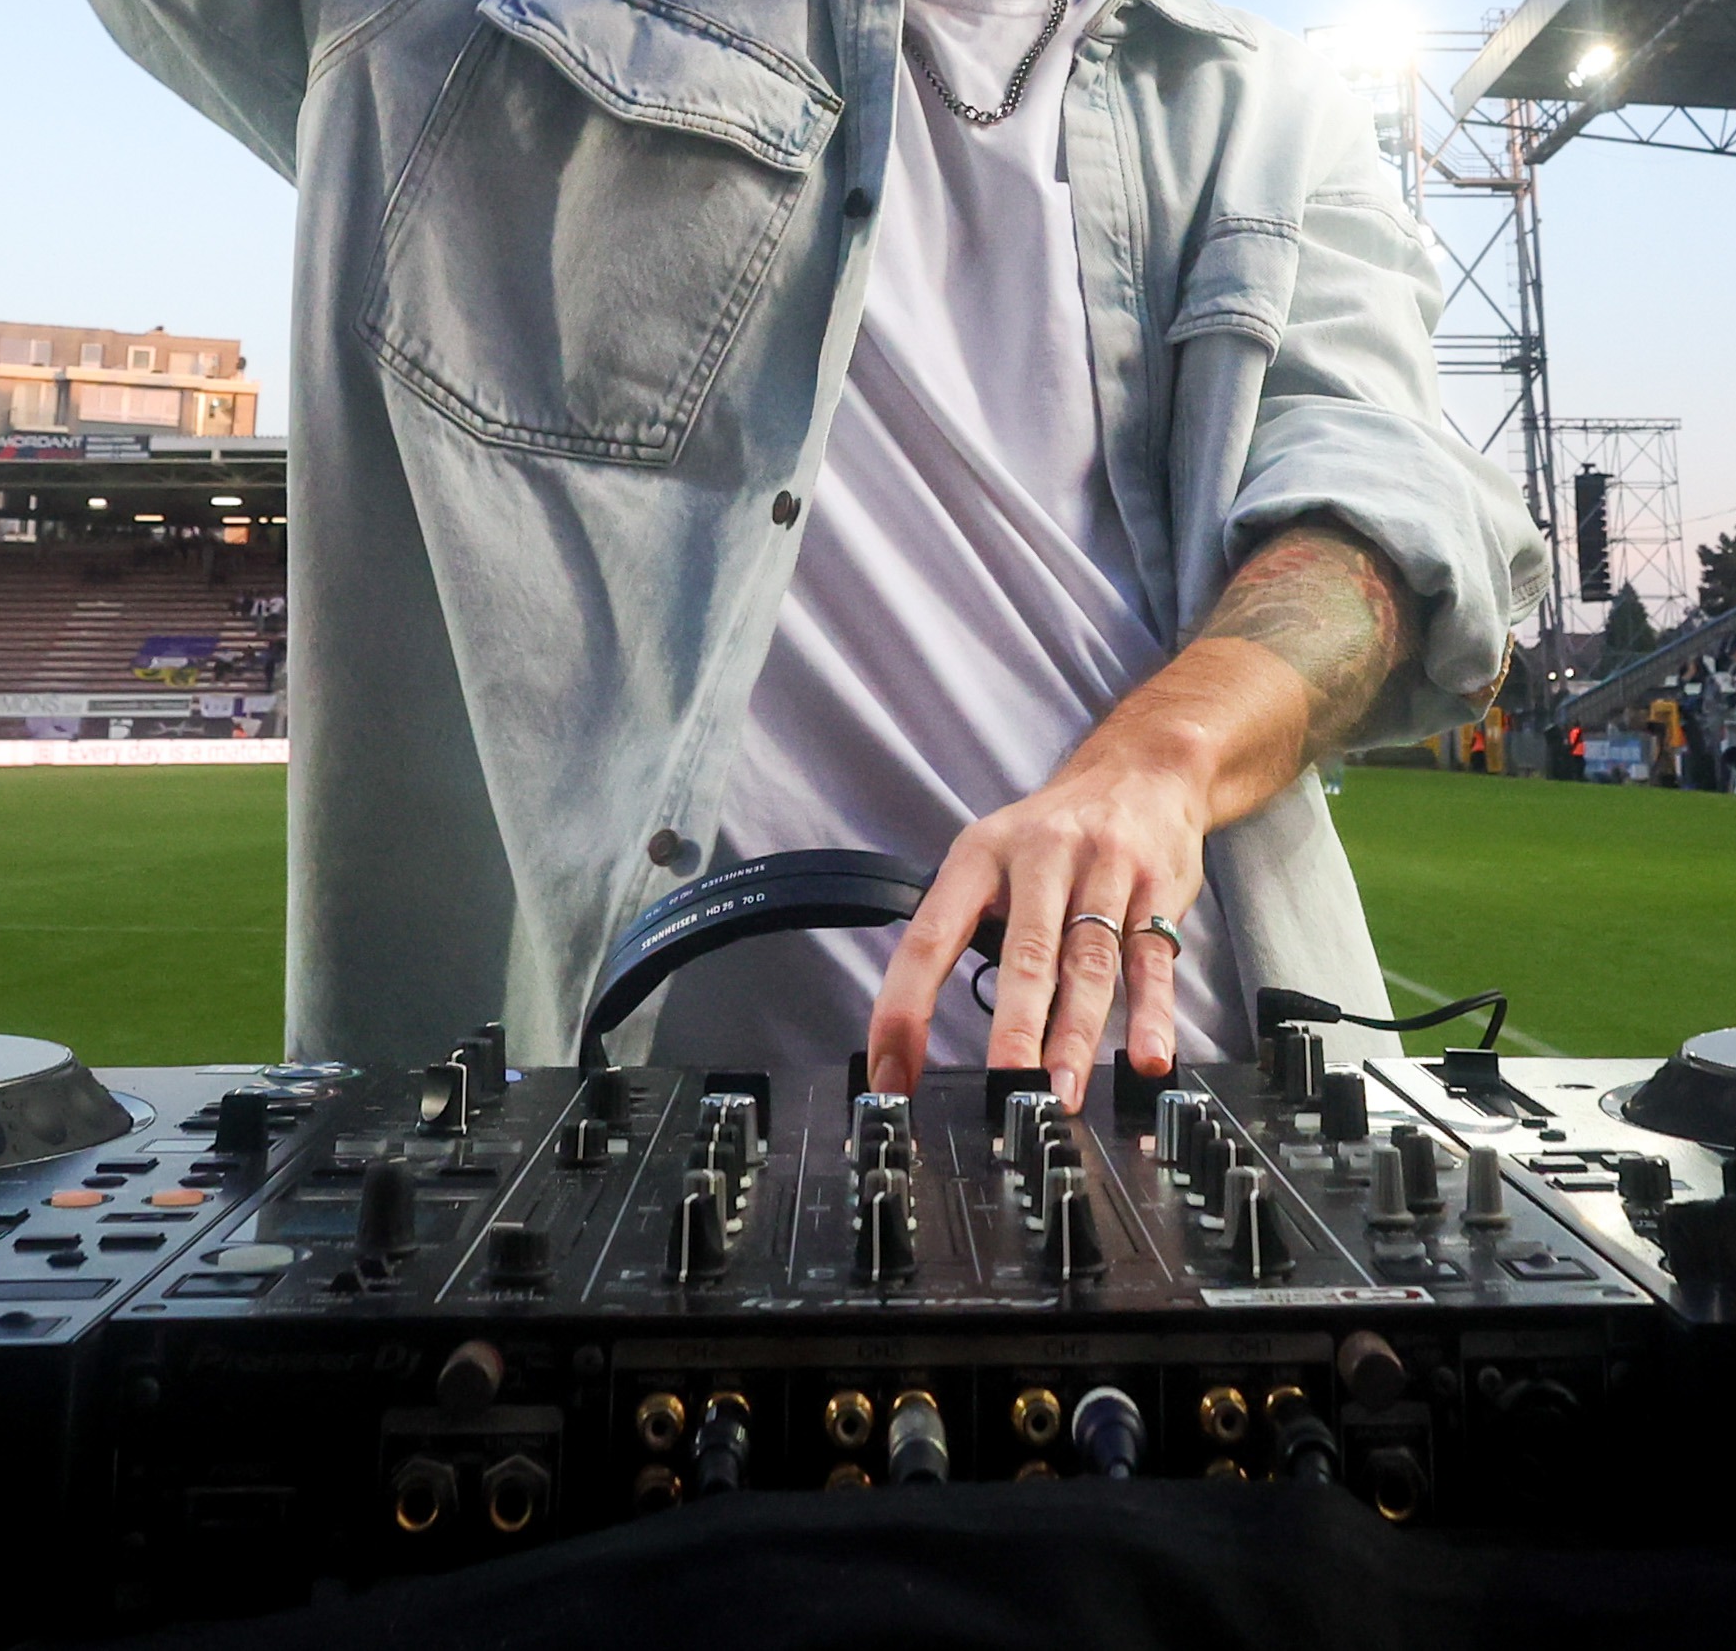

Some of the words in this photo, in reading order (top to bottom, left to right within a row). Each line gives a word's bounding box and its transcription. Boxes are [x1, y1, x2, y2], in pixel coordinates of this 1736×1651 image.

[127, 743, 162, 763] day
[641, 913, 698, 951] SENNHEISER
[706, 905, 721, 917] HD
[742, 895, 754, 905] 70
